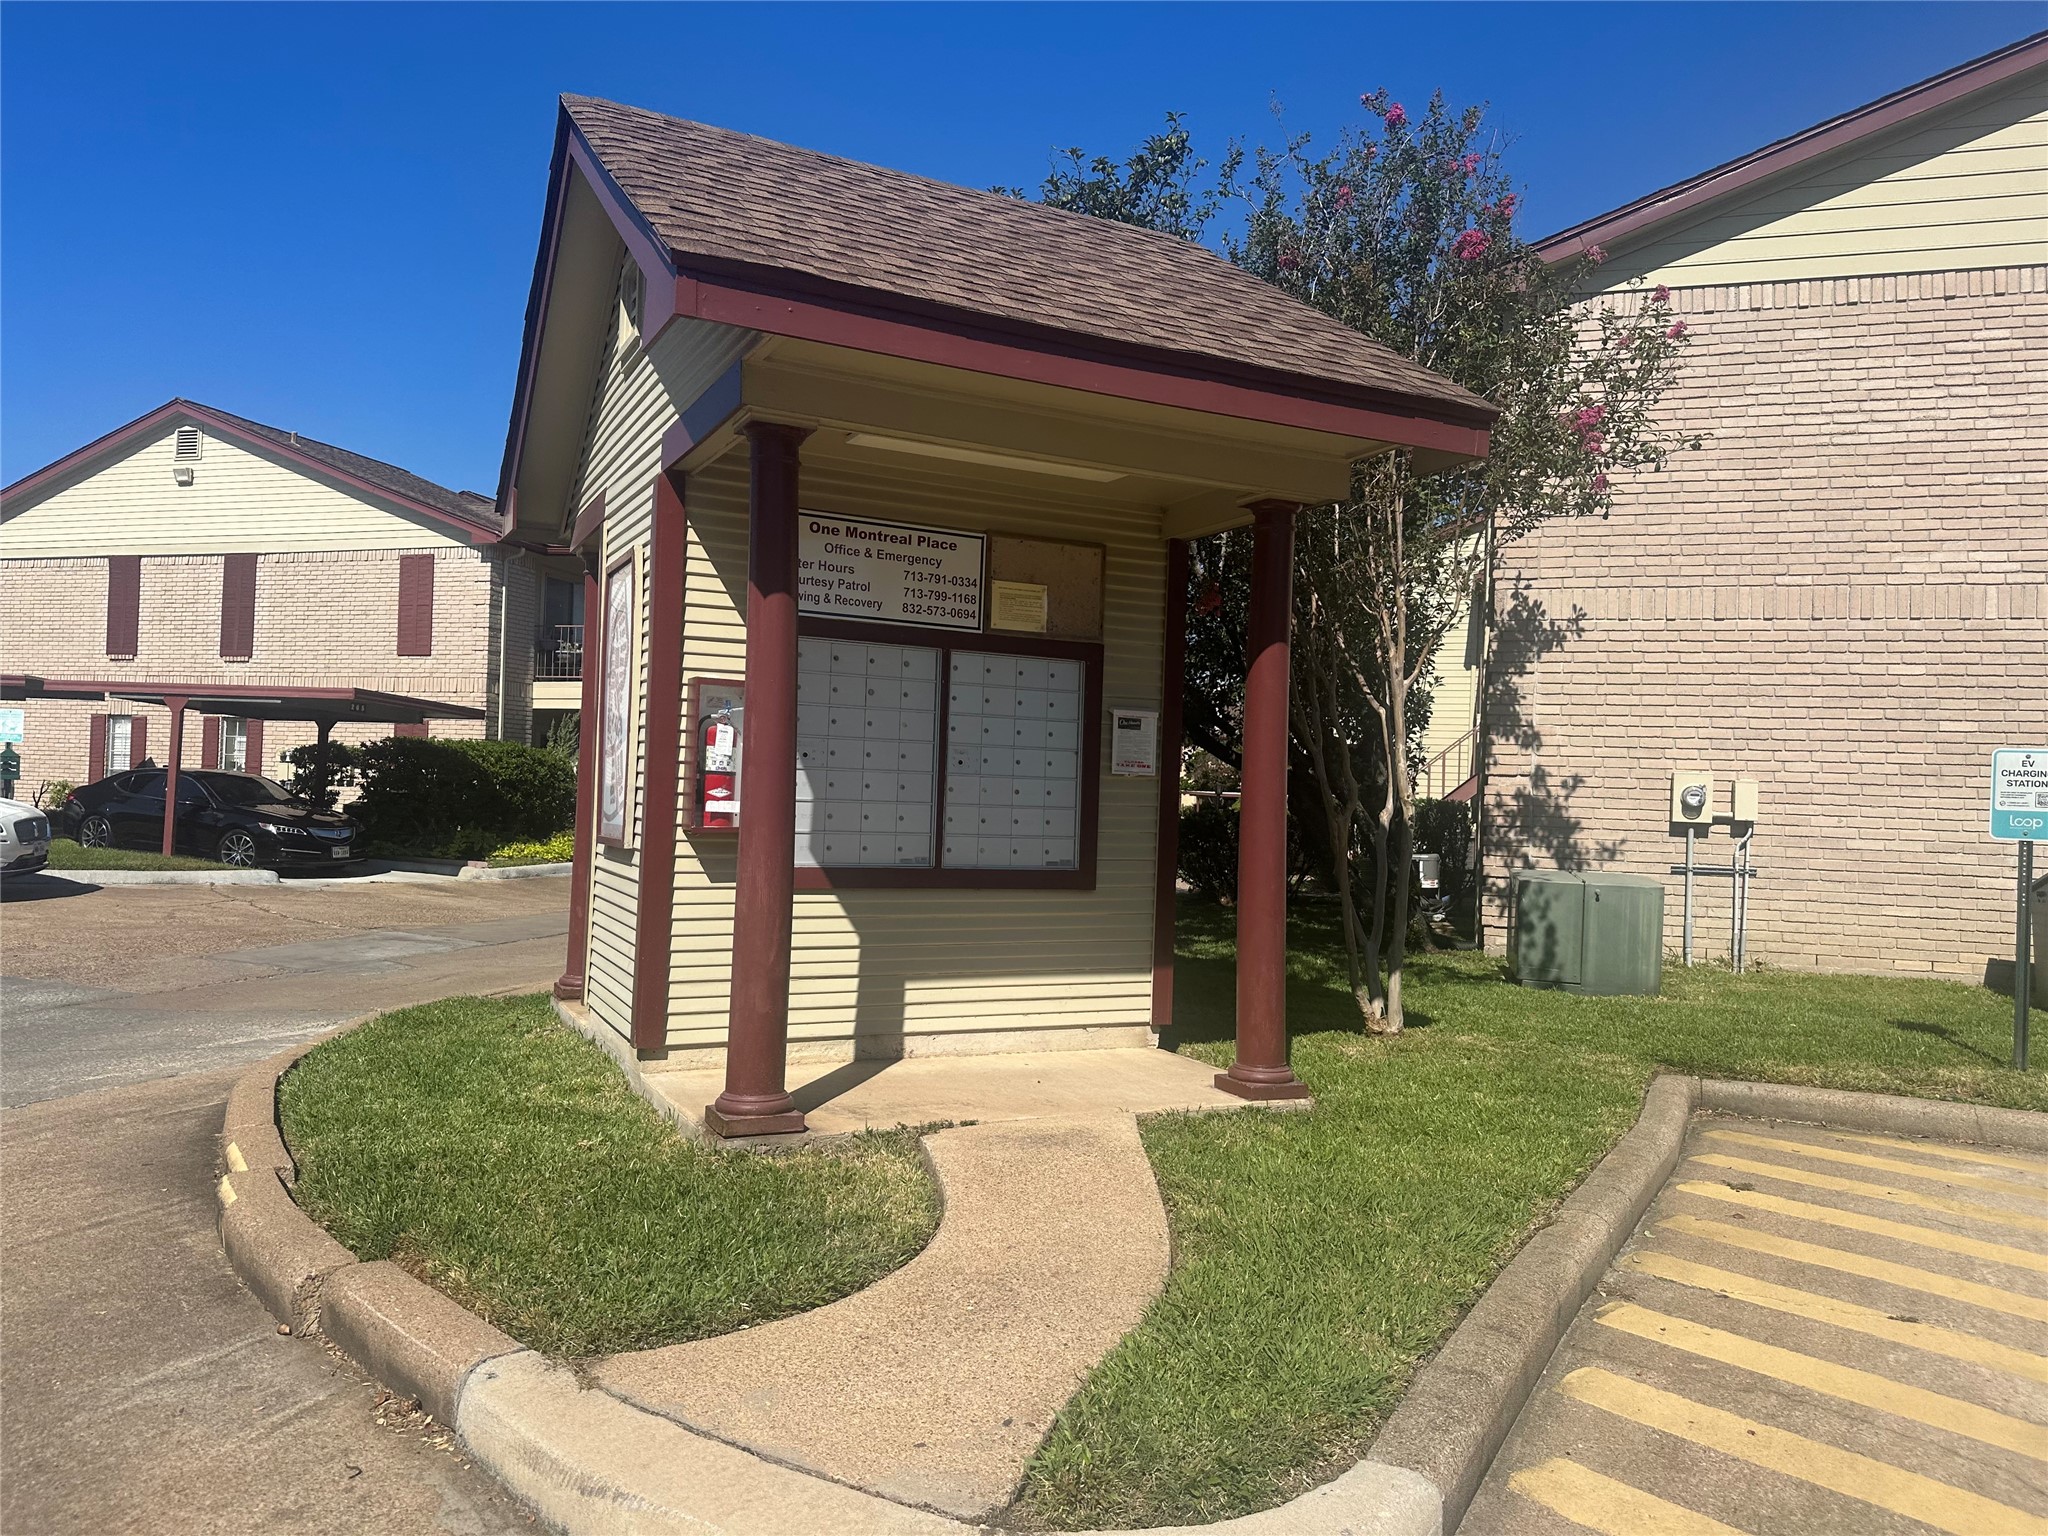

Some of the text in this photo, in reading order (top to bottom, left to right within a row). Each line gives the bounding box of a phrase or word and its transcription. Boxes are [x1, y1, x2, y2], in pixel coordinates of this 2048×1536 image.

[809, 521, 958, 551] One Montreal Place
[824, 542, 942, 569] Office & Emergency
[798, 559, 855, 574] ter Hours
[798, 575, 871, 592] urtesy Patrol
[903, 570, 977, 588] 713-791-0334
[823, 593, 831, 604] &
[834, 594, 883, 611] Recovery
[903, 587, 977, 605] 713-799-1168
[902, 603, 976, 620] 832-573-0694
[2021, 760, 2035, 768] EV
[2001, 769, 2048, 778] CHARGIN
[2006, 779, 2048, 788] STATION
